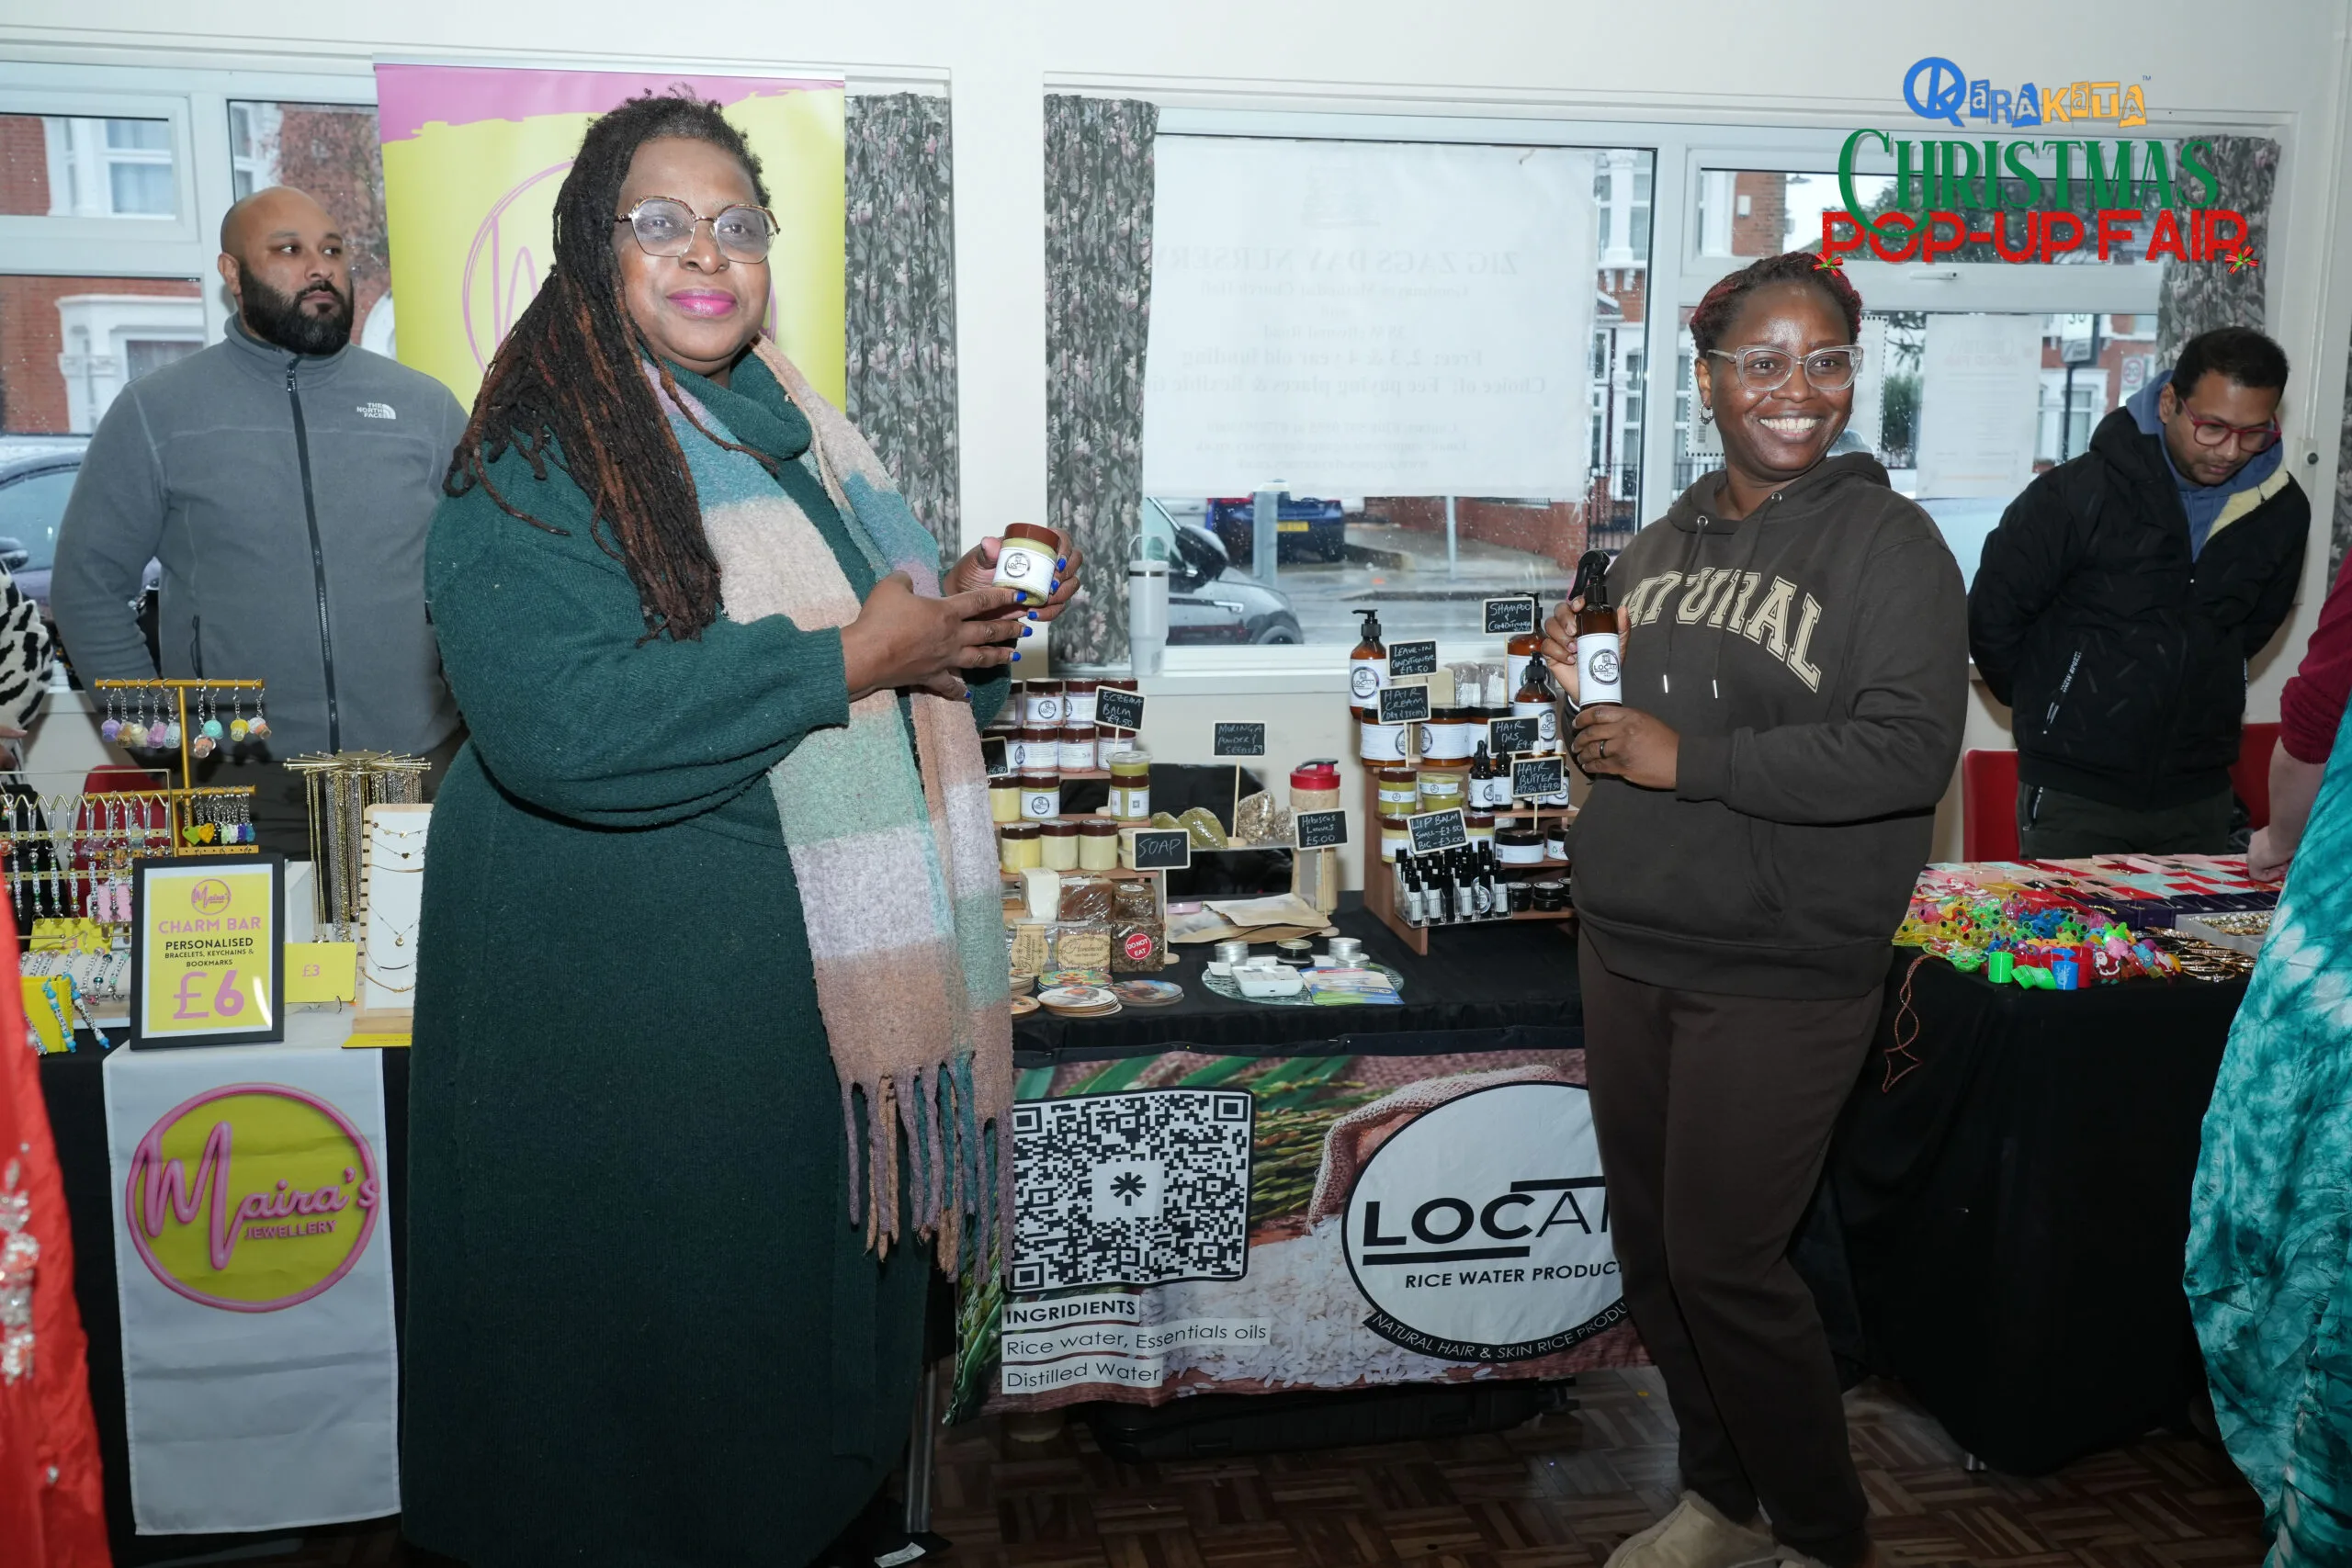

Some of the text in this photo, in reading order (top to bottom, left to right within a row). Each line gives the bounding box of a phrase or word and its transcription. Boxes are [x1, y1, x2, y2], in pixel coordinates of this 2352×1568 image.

[1489, 603, 1532, 616] SHAMPOO
[1619, 567, 1823, 694] ATURAL
[1102, 691, 1143, 706] ECZEMA
[1384, 687, 1422, 703] HAIR
[1102, 703, 1132, 718] BALM
[1496, 720, 1526, 734] HAIR
[1517, 761, 1550, 776] HAIR
[1434, 812, 1458, 826] BALM
[1138, 837, 1182, 859] SOAP
[158, 916, 262, 934] CHARM BAR
[165, 937, 254, 951] PERSONALISED
[1134, 947, 1147, 956] EAT
[207, 948, 246, 957] KEYCHAINS
[186, 959, 233, 968] BOOKMARKS
[301, 964, 321, 977] £3
[173, 969, 244, 1020] £6
[143, 1120, 380, 1271] Maira's
[245, 1219, 338, 1240] JEWELLERY
[1405, 1272, 1453, 1289] RICE
[1459, 1269, 1525, 1285] WATER
[1006, 1299, 1136, 1325] INGRIDIENTS
[1372, 1313, 1434, 1352] NATURAL
[1437, 1340, 1476, 1358] HAIR
[1497, 1344, 1533, 1359] SKIN
[1538, 1332, 1575, 1353] RICE
[1577, 1302, 1628, 1338] PRODU
[1007, 1323, 1267, 1356] Rice water, Essentials oils
[1007, 1362, 1160, 1388] Distilled Water
